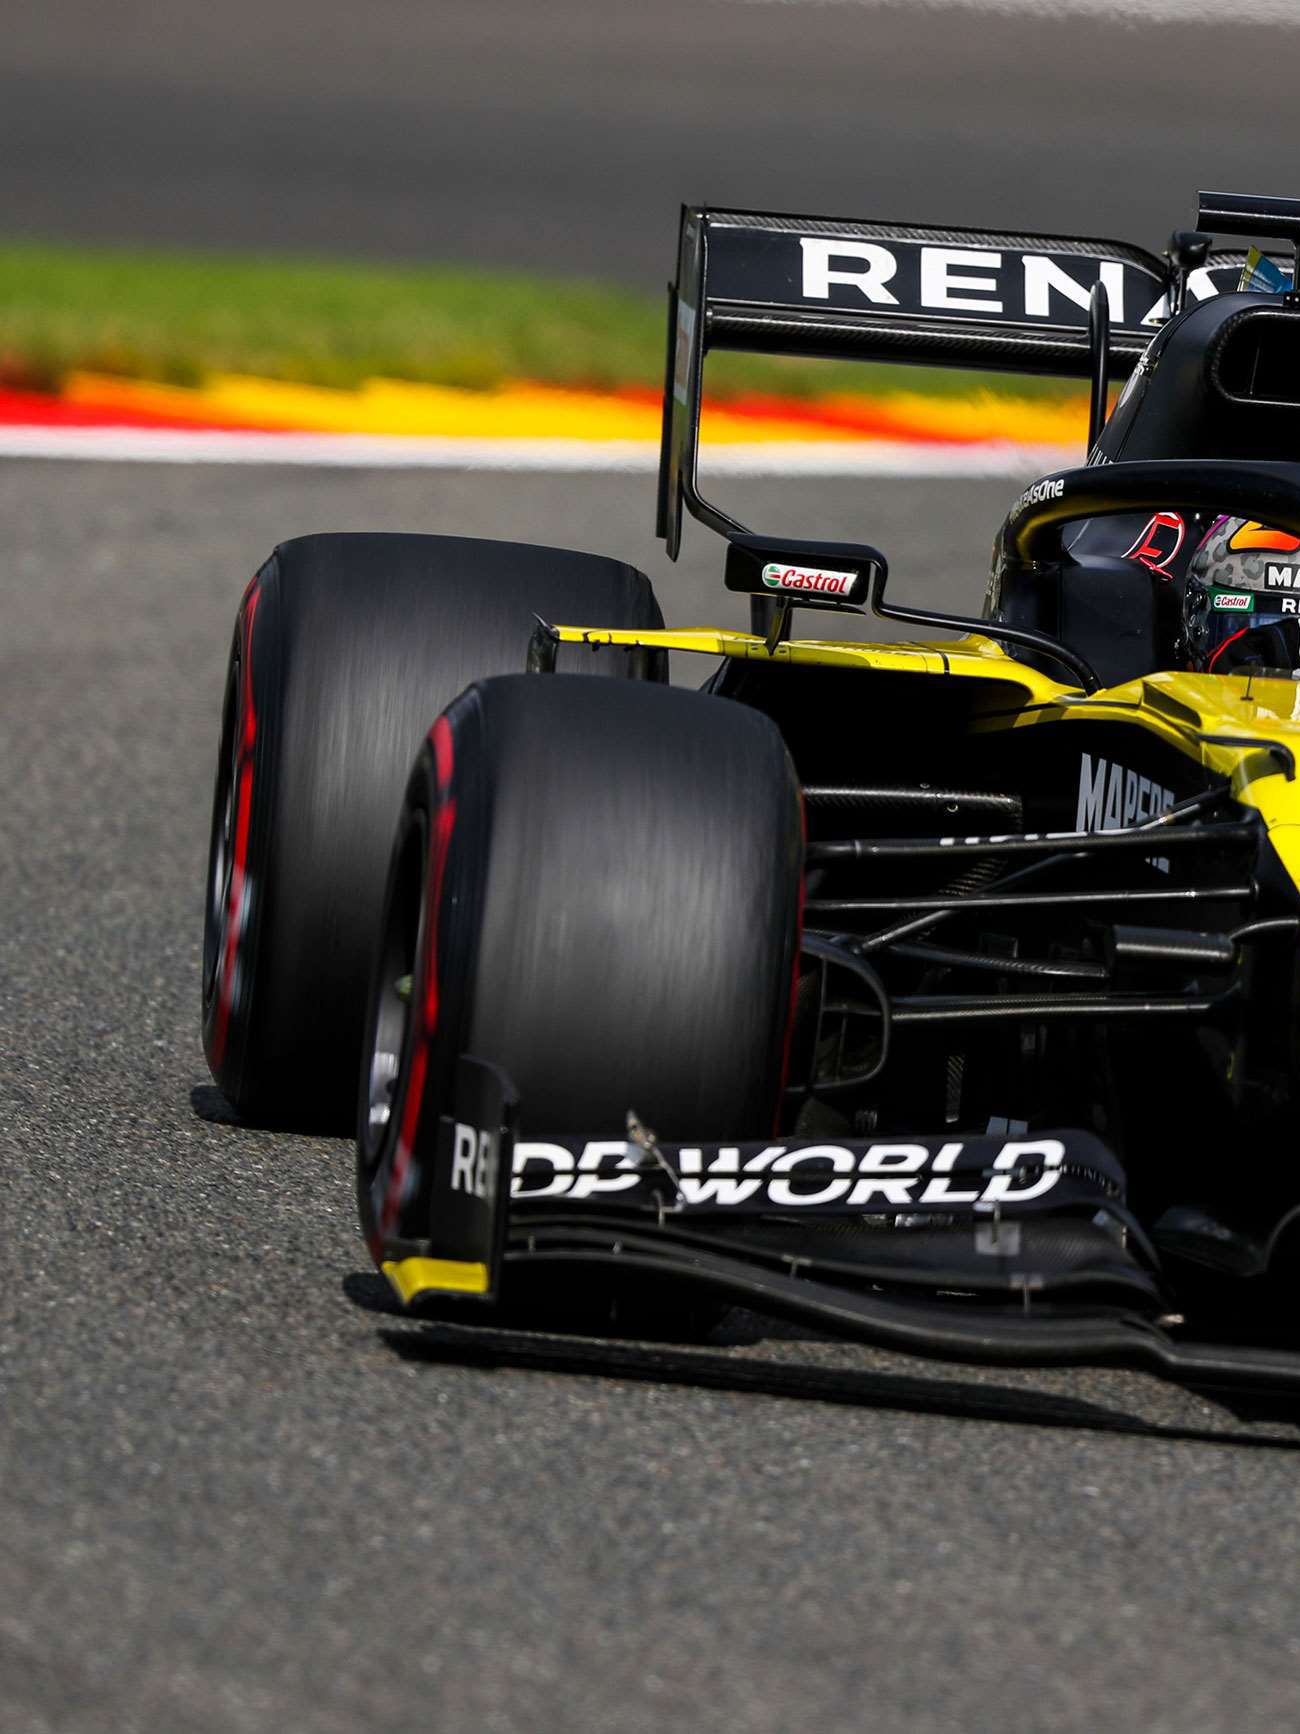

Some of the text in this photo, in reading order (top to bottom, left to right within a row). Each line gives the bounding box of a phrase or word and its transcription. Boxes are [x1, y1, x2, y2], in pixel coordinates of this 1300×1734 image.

[781, 569, 849, 593] Castrol
[510, 1139, 1066, 1204] DP WORLD
